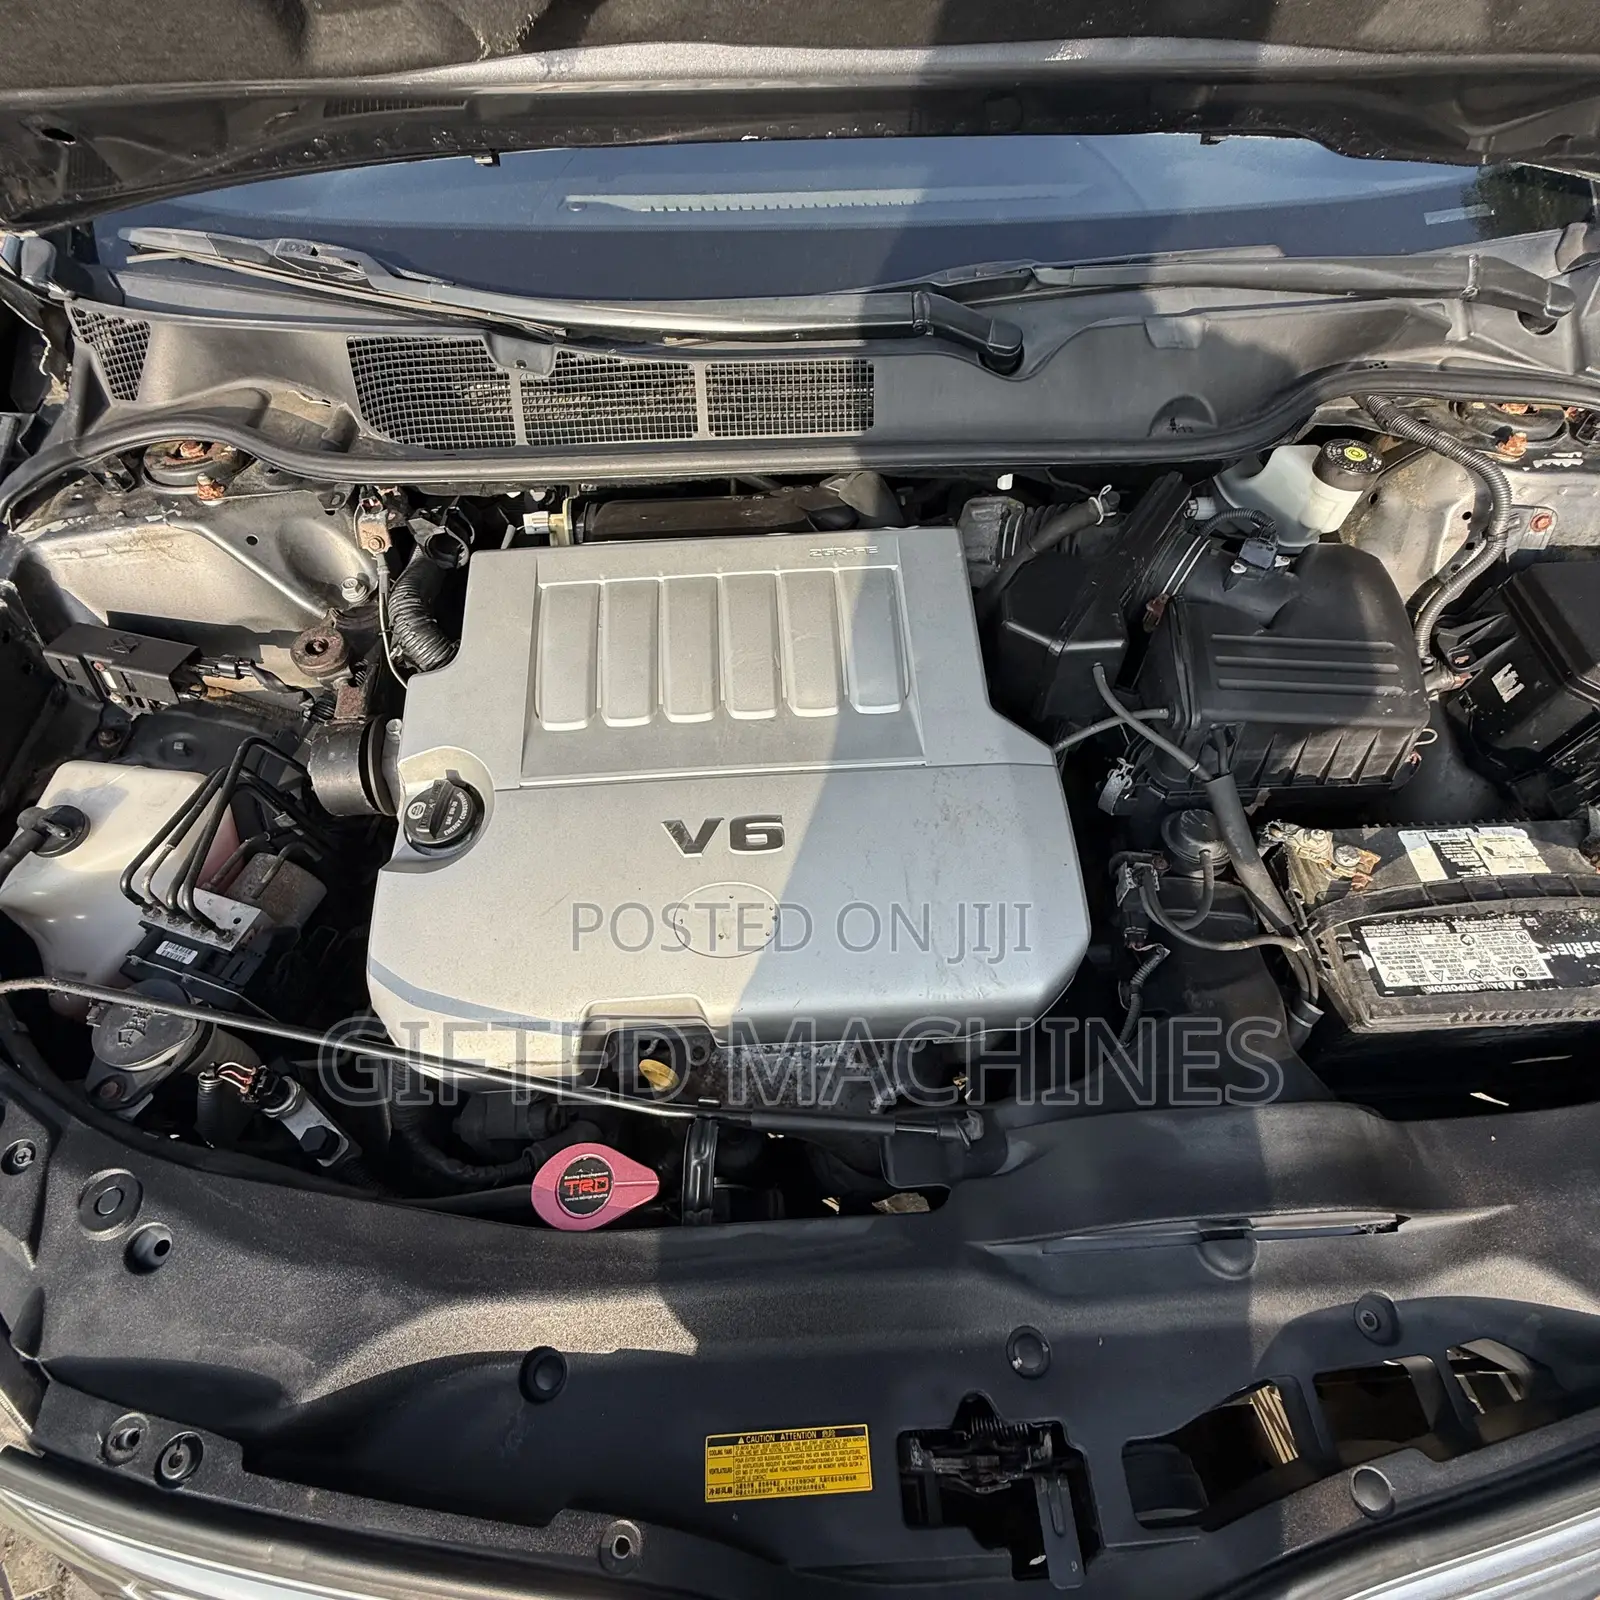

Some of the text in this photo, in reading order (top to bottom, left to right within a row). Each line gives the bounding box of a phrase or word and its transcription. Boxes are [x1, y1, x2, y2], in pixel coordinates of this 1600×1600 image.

[809, 546, 878, 557] 2GR-FE
[444, 819, 462, 836] ENERGY
[661, 814, 785, 858] V6
[563, 1177, 609, 1196] TRD
[746, 1434, 775, 1443] CAUTION
[780, 1431, 817, 1441] ATTENTION
